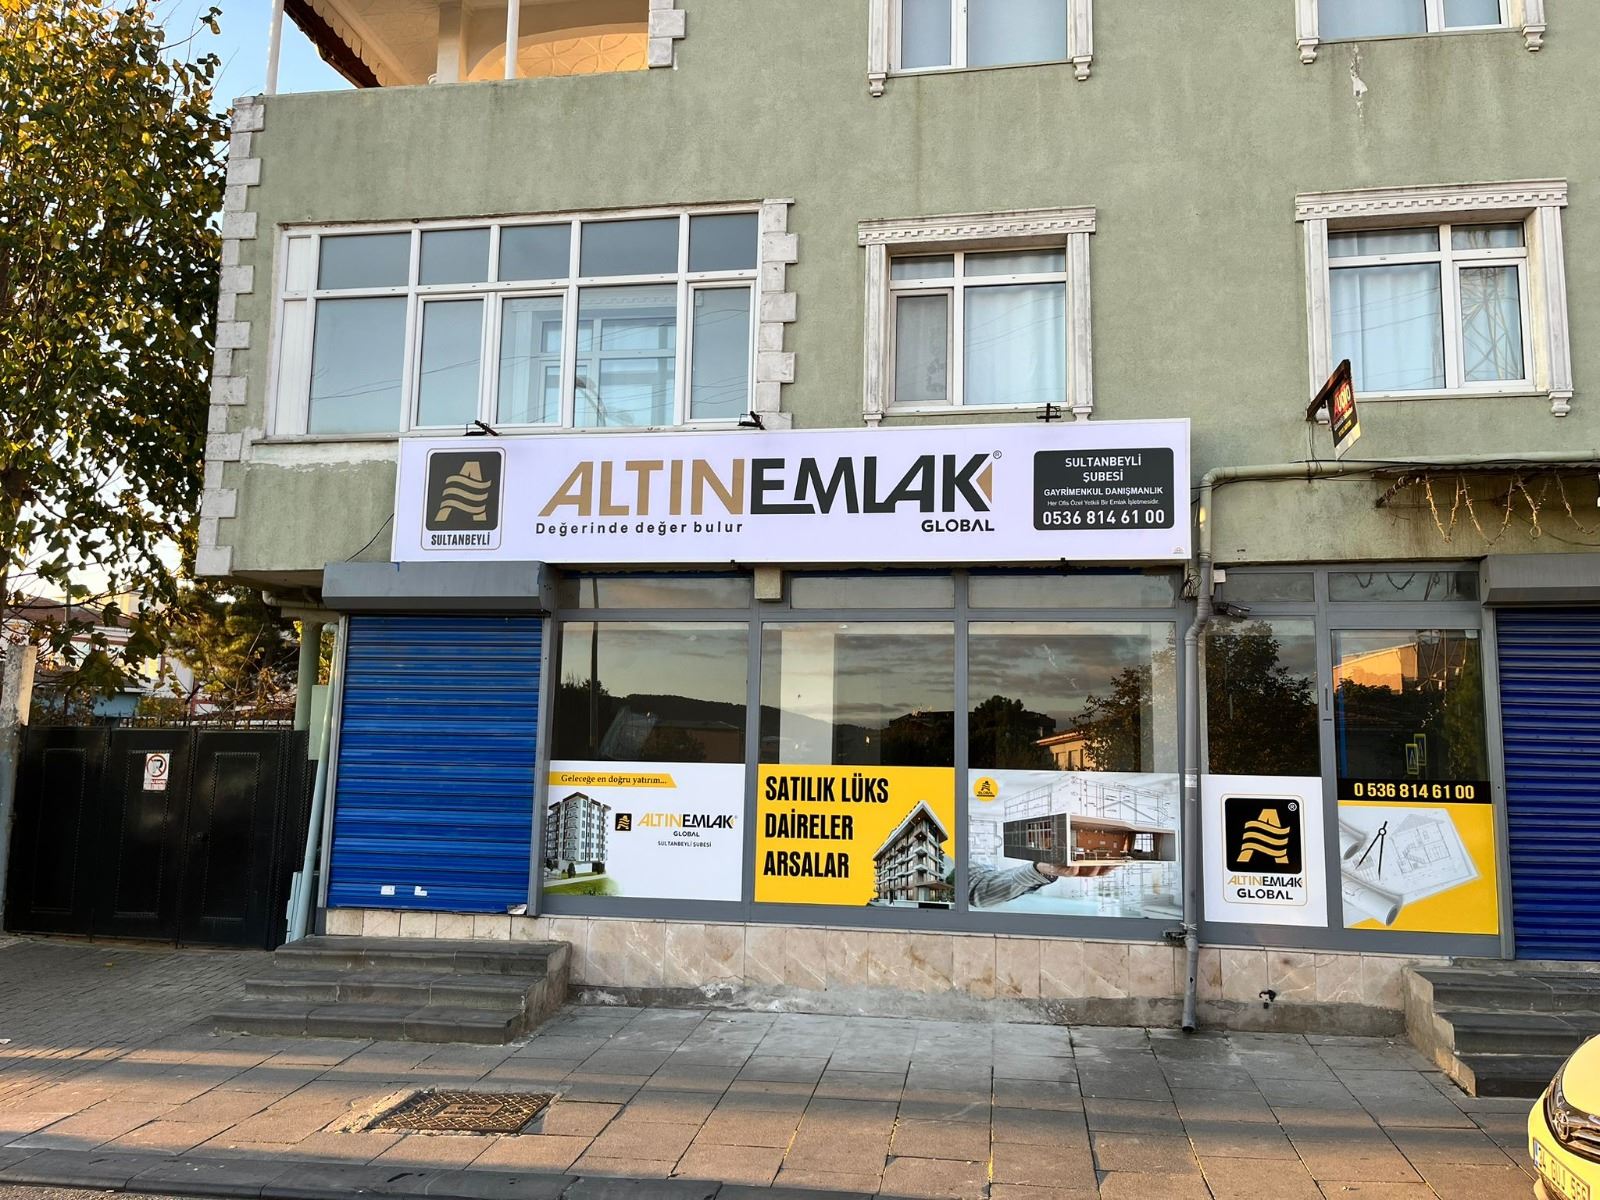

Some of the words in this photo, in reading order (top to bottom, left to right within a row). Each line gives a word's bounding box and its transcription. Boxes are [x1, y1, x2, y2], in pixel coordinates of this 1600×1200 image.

[1064, 453, 1142, 468] SULTANBEYLİ
[1082, 469, 1124, 483] ŞUBESİ
[537, 453, 992, 517] ALTINEMLAK
[1043, 486, 1104, 497] GAYRİMENKUL
[1105, 486, 1164, 497] DANIŞMANLIK
[1043, 510, 1082, 525] 0536
[1086, 510, 1116, 524] 814
[1121, 509, 1139, 524] 61
[1145, 509, 1165, 524] 00
[535, 521, 629, 537] Değerinde
[635, 521, 688, 536] değer
[693, 520, 744, 534] bulur
[921, 519, 995, 533] GLOBAL
[431, 532, 491, 546] SULTANBEYLİ
[560, 774, 596, 784] Geleceğe
[608, 775, 631, 785] doğru
[765, 775, 836, 802] SATILIK
[841, 773, 889, 803] LÜKS
[1353, 782, 1364, 797] 0
[1367, 782, 1396, 798] 536
[1399, 783, 1429, 798] 814
[1432, 784, 1451, 799] 61
[1455, 784, 1475, 800] 00
[637, 812, 734, 829] ALTINEMLAK
[765, 808, 854, 841] DAİRELER
[673, 830, 700, 838] GLOBAL
[657, 840, 692, 848] SULTANBEYLİ
[763, 850, 849, 879] ARSALAR
[1228, 875, 1303, 888] ALTINEMLAK
[1237, 887, 1294, 901] GLOBAL
